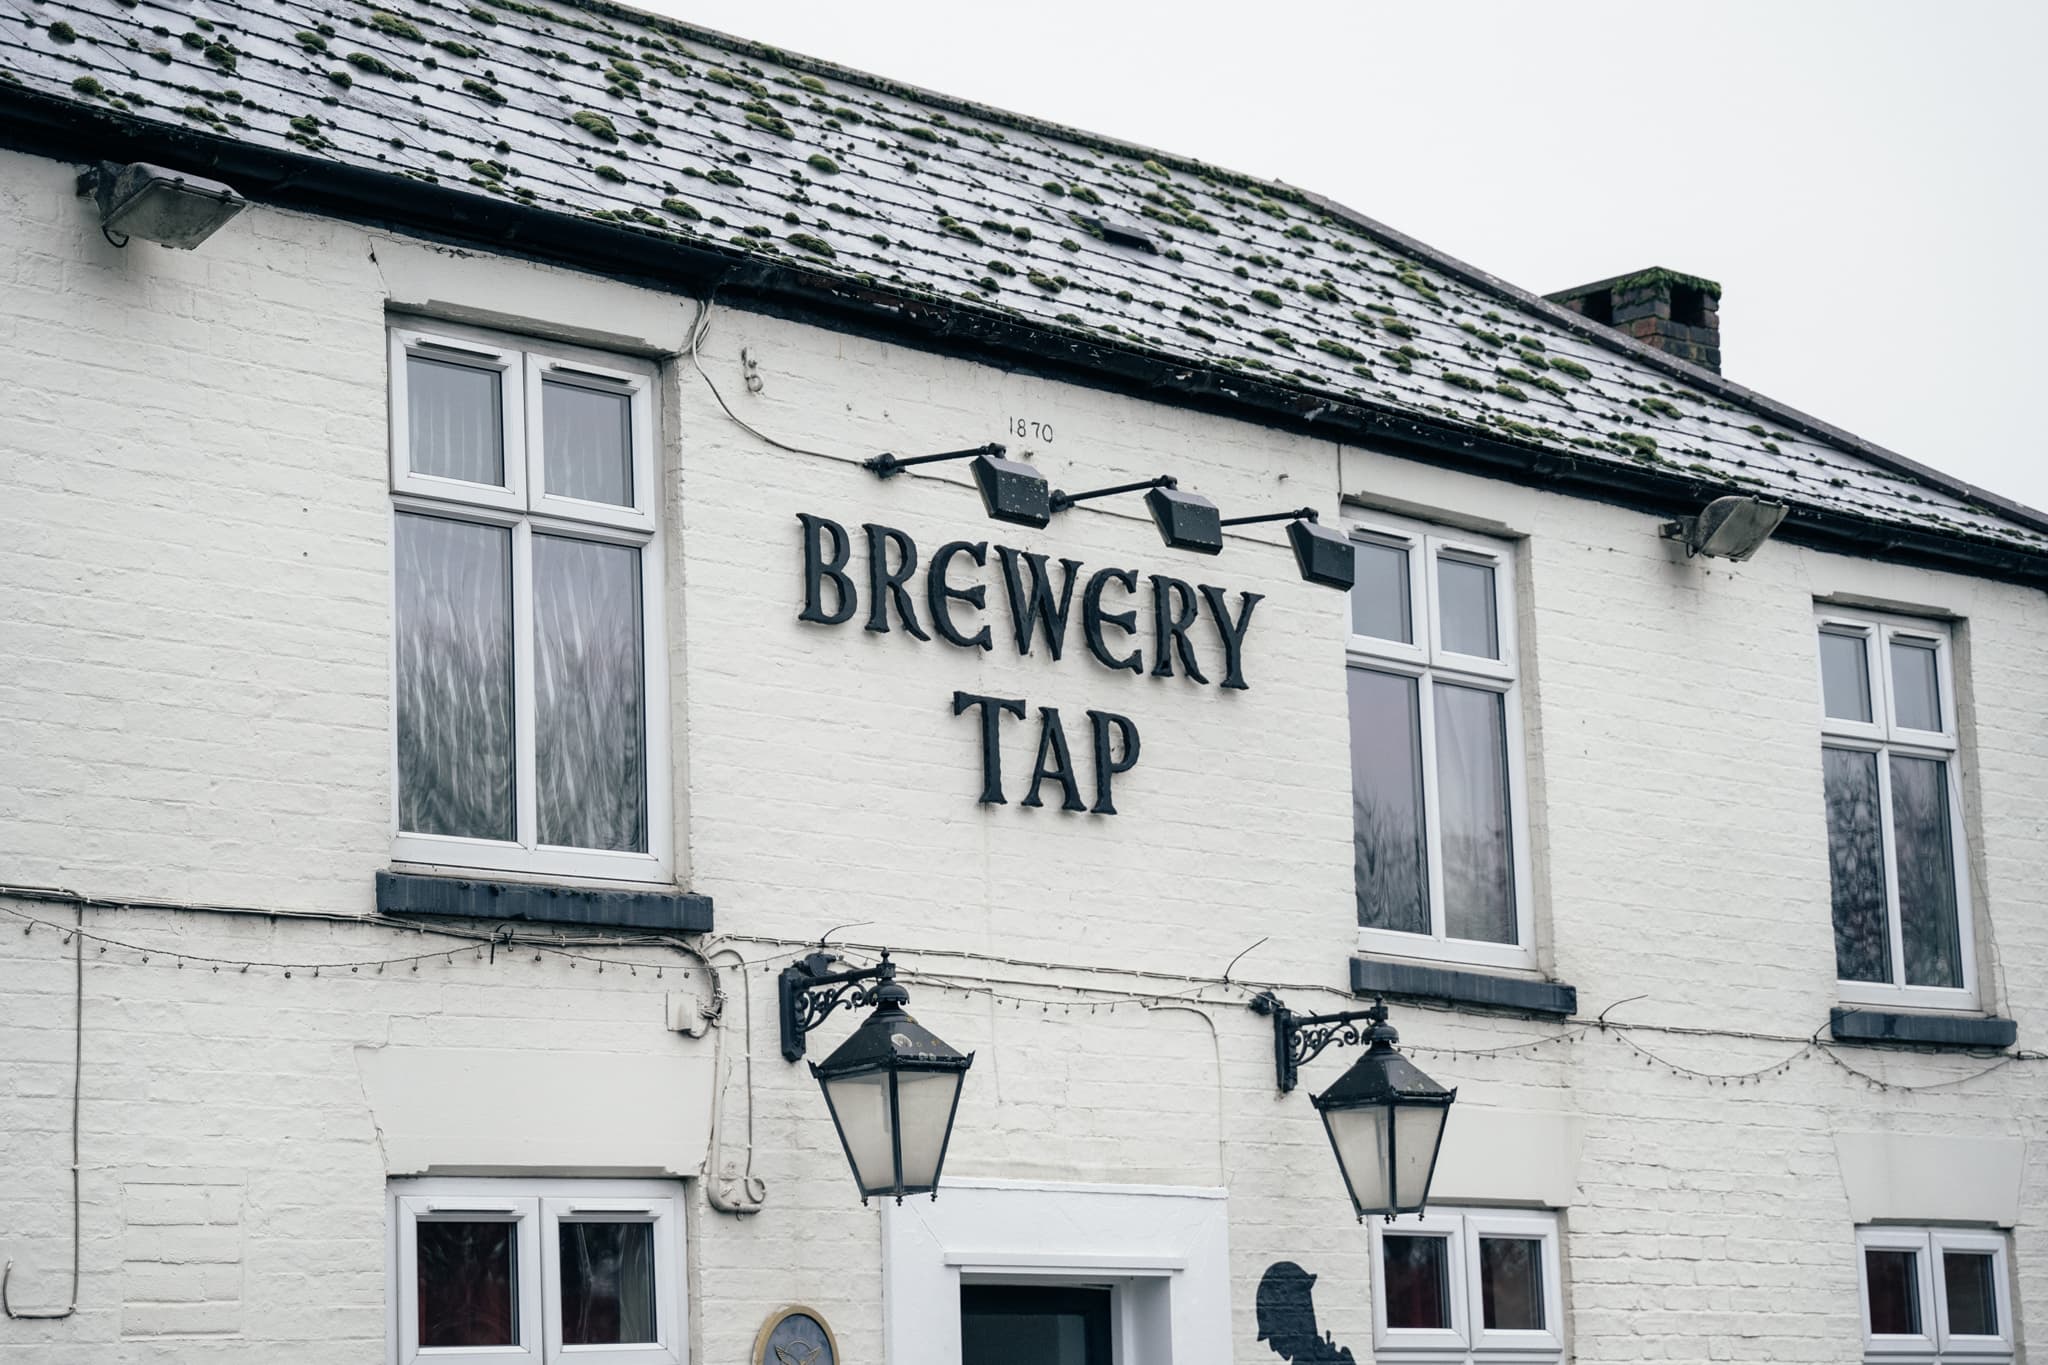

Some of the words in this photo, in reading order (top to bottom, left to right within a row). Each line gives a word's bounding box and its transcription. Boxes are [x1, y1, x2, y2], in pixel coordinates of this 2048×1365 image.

[1008, 415, 1054, 443] 1870
[796, 513, 1265, 691] BREWERY
[953, 691, 1141, 815] TAP
